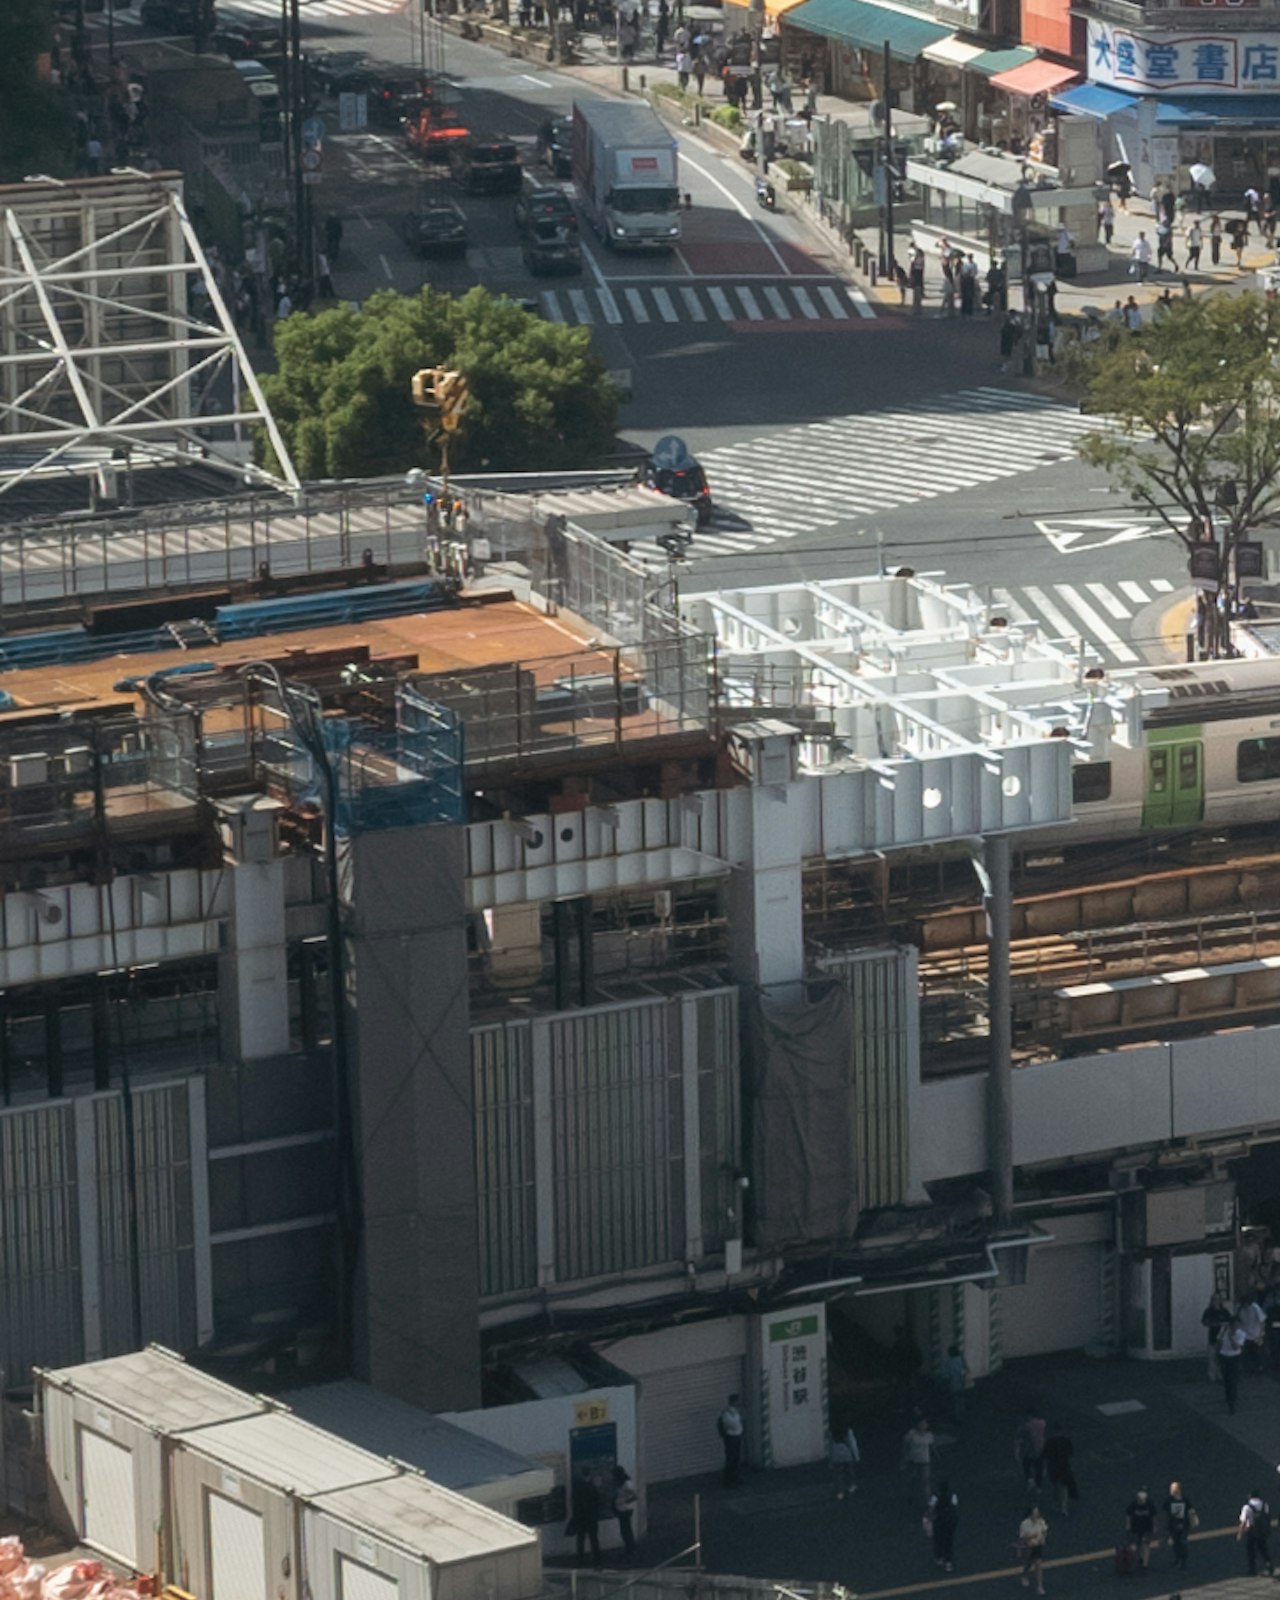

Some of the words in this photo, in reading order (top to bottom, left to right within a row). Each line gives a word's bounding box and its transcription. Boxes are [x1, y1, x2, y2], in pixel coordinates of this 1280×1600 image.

[1093, 36, 1280, 82] 大盛堂書店
